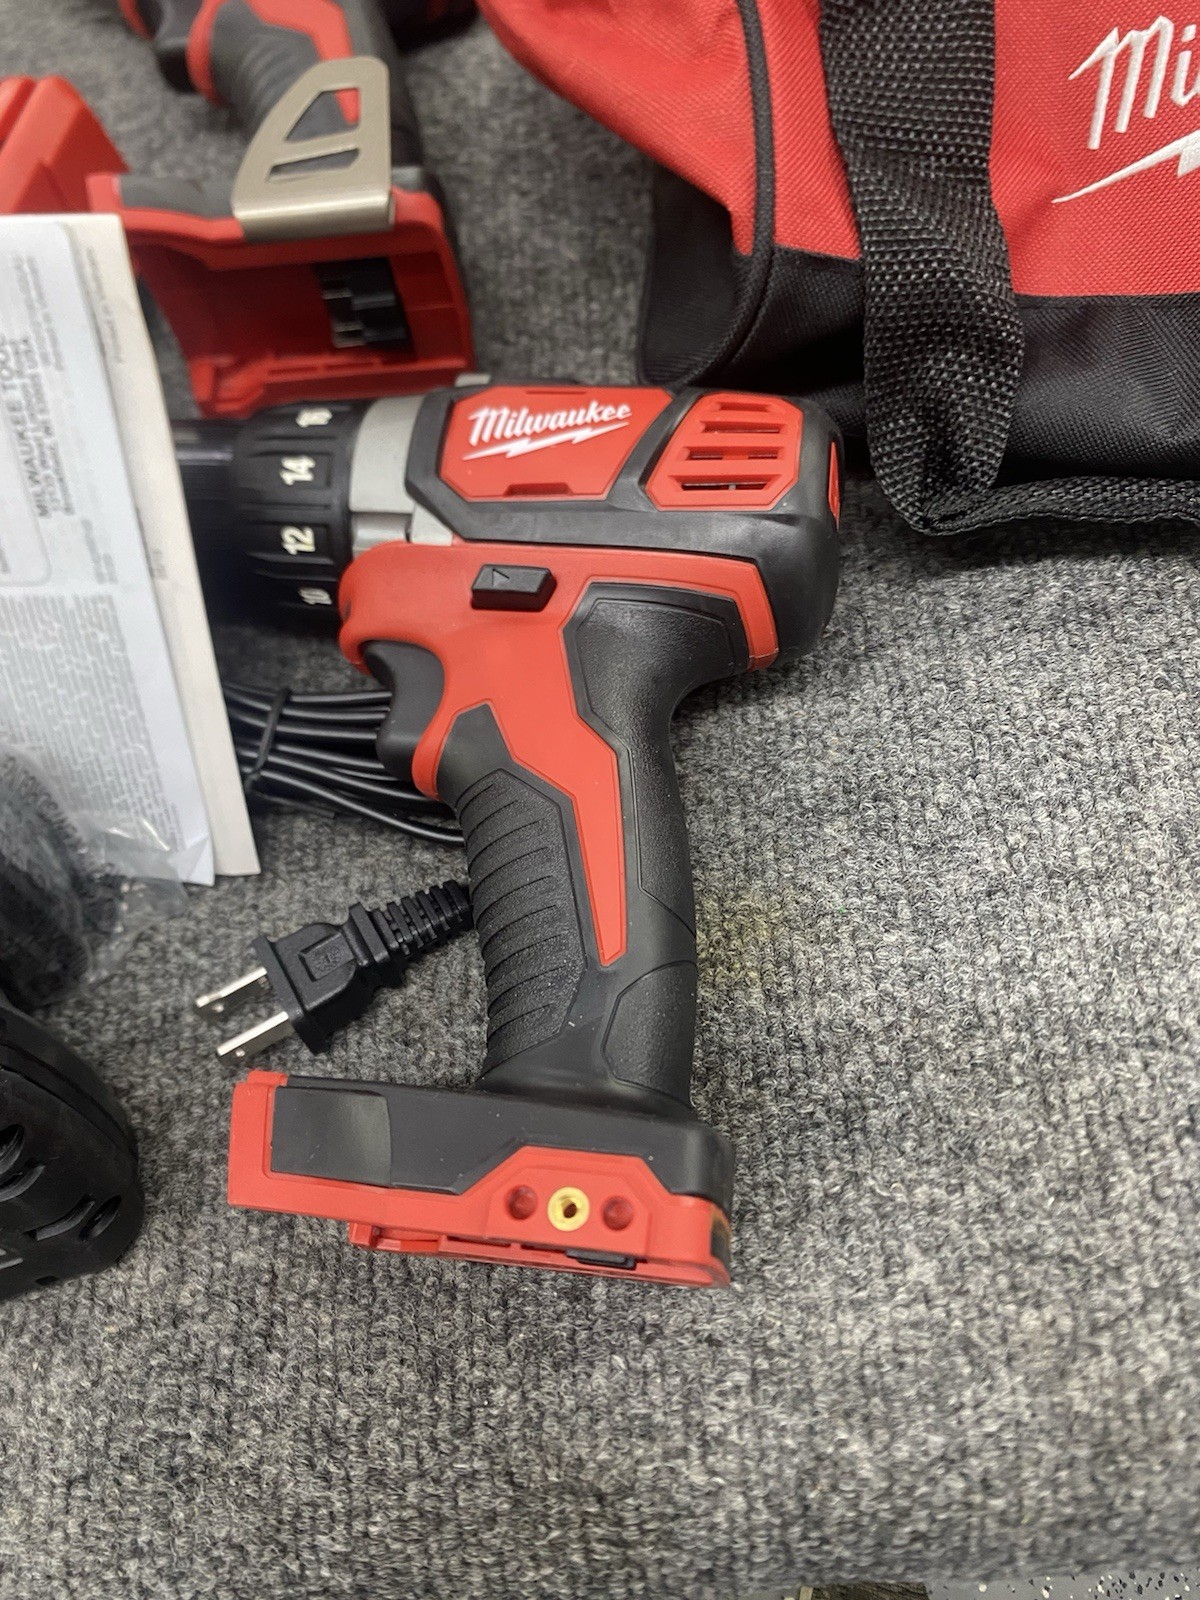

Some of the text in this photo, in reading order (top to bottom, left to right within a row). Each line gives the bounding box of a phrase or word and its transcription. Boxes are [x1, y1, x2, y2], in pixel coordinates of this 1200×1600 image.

[1068, 15, 1200, 150] Mi
[469, 400, 632, 446] Milwaukee
[6, 399, 49, 517] MILWAUKEE
[280, 455, 316, 486] 14
[281, 525, 316, 555] 12
